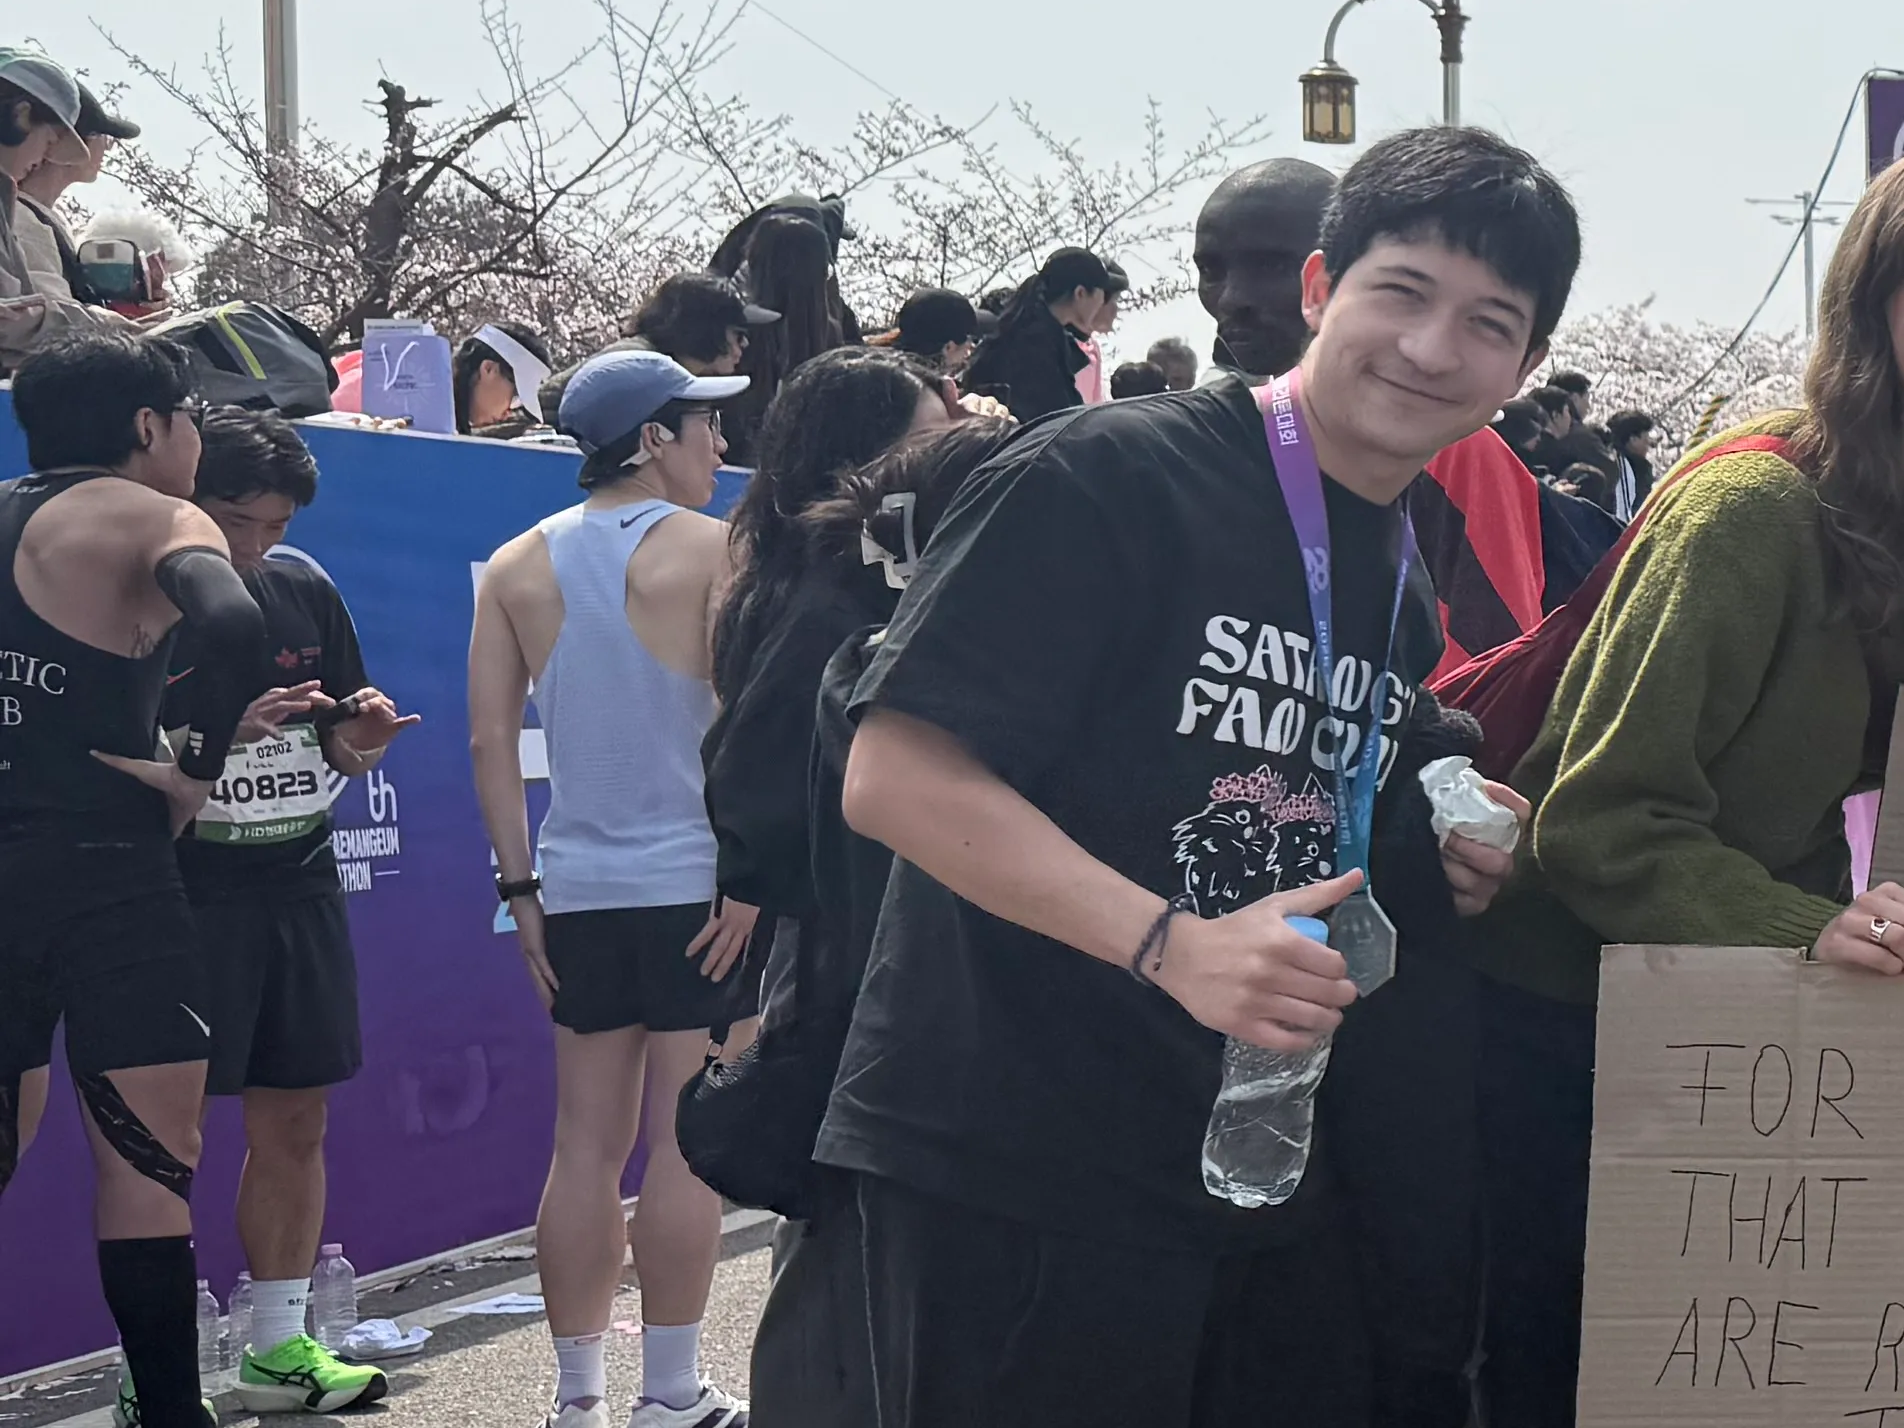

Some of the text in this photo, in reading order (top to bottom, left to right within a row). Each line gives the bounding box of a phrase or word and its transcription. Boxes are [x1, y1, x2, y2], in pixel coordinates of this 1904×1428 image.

[0, 651, 67, 695] TIC
[256, 742, 293, 759] 02102
[1176, 677, 1306, 756] FAN
[210, 770, 319, 805] 40823
[1664, 1044, 1865, 1139] FOR
[1669, 1169, 1870, 1271] THAT
[1654, 1296, 1820, 1390] ARE
